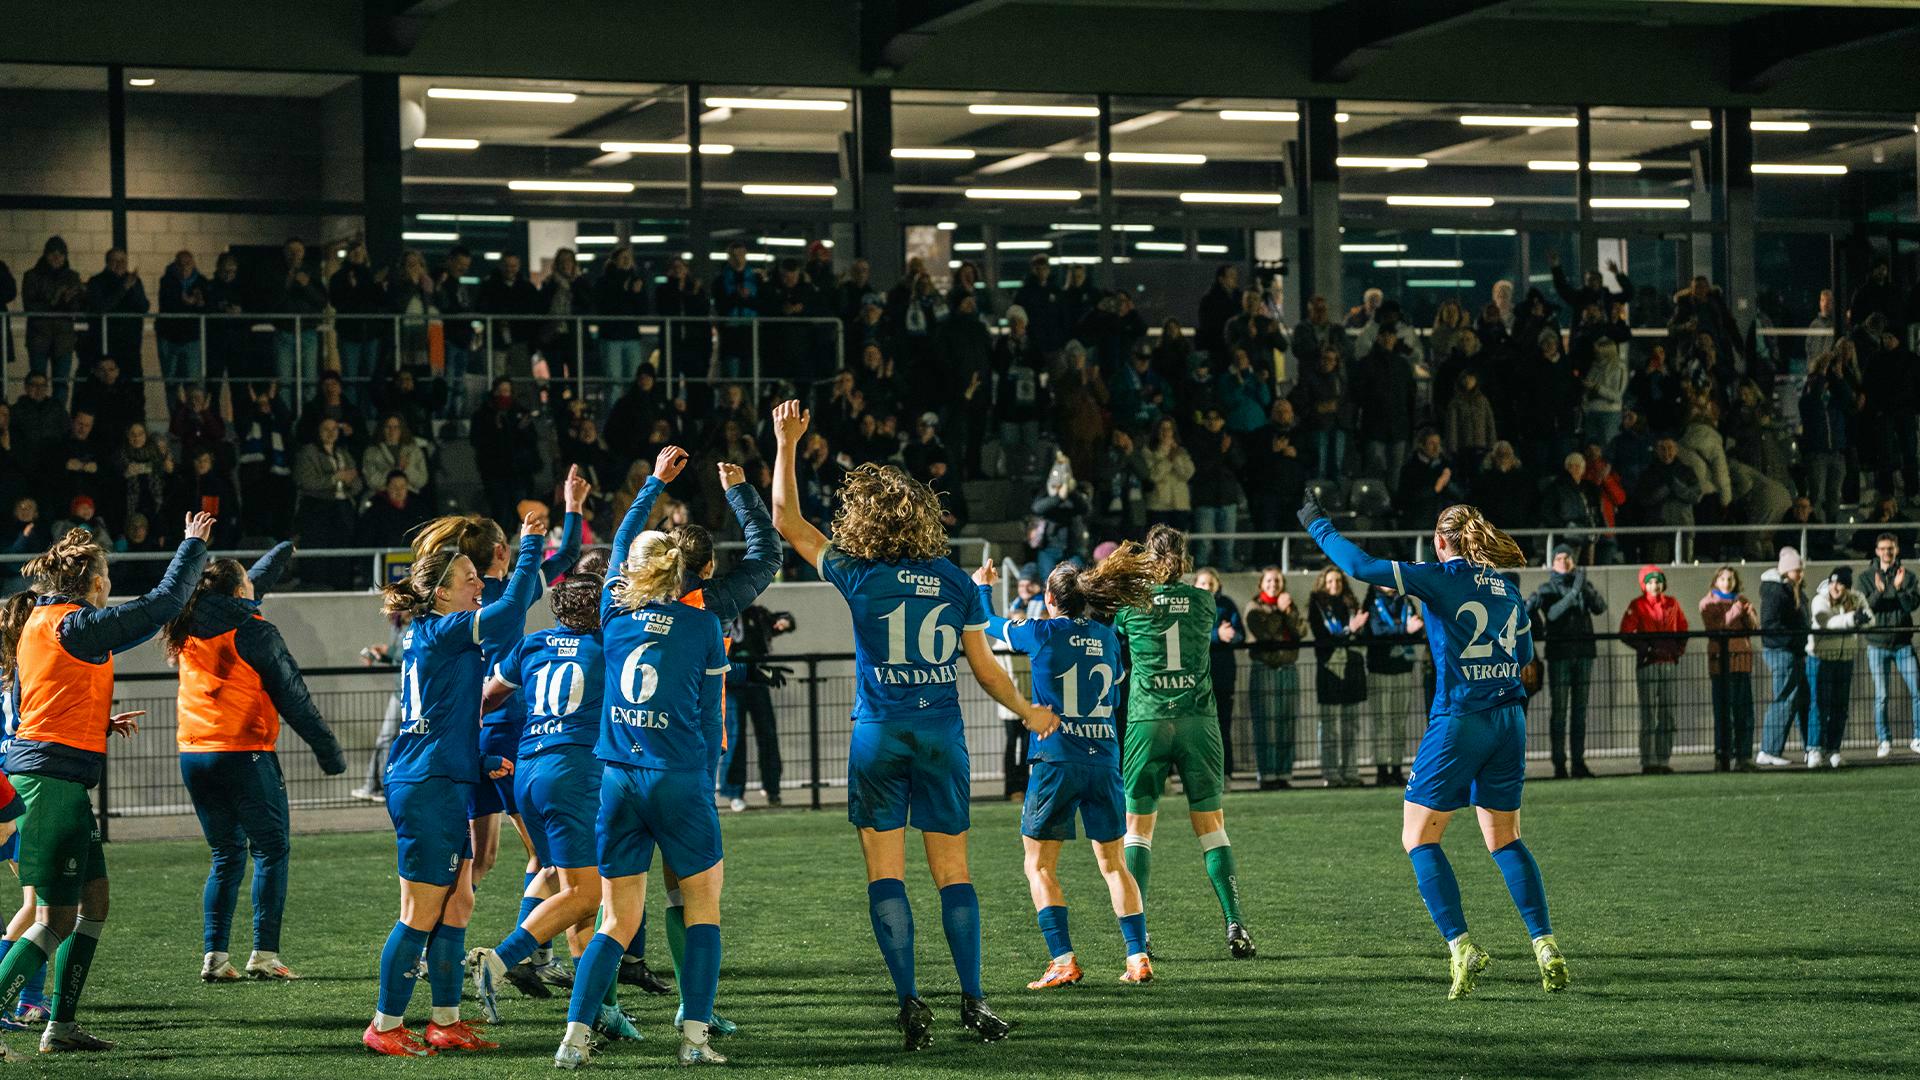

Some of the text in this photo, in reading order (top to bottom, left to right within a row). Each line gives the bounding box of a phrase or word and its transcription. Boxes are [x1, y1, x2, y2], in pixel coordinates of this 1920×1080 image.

[897, 570, 941, 586] Circus
[918, 586, 939, 595] Daily
[1153, 594, 1190, 605] Circus
[632, 609, 675, 625] Circus
[646, 623, 669, 634] Daily
[878, 601, 951, 665] 16
[1455, 600, 1518, 659] 24
[546, 635, 580, 647] Circus
[1069, 635, 1103, 648] Circus
[1159, 619, 1186, 671] 1
[558, 648, 576, 656] Daily
[620, 641, 659, 704] 6
[874, 667, 910, 685] VAN
[1154, 674, 1196, 689] MAES
[531, 660, 585, 718] 10
[1054, 662, 1113, 718] 12
[611, 706, 669, 730] ENGELS
[2, 974, 25, 1004] CRAFT
[70, 964, 83, 996] CRAFT
